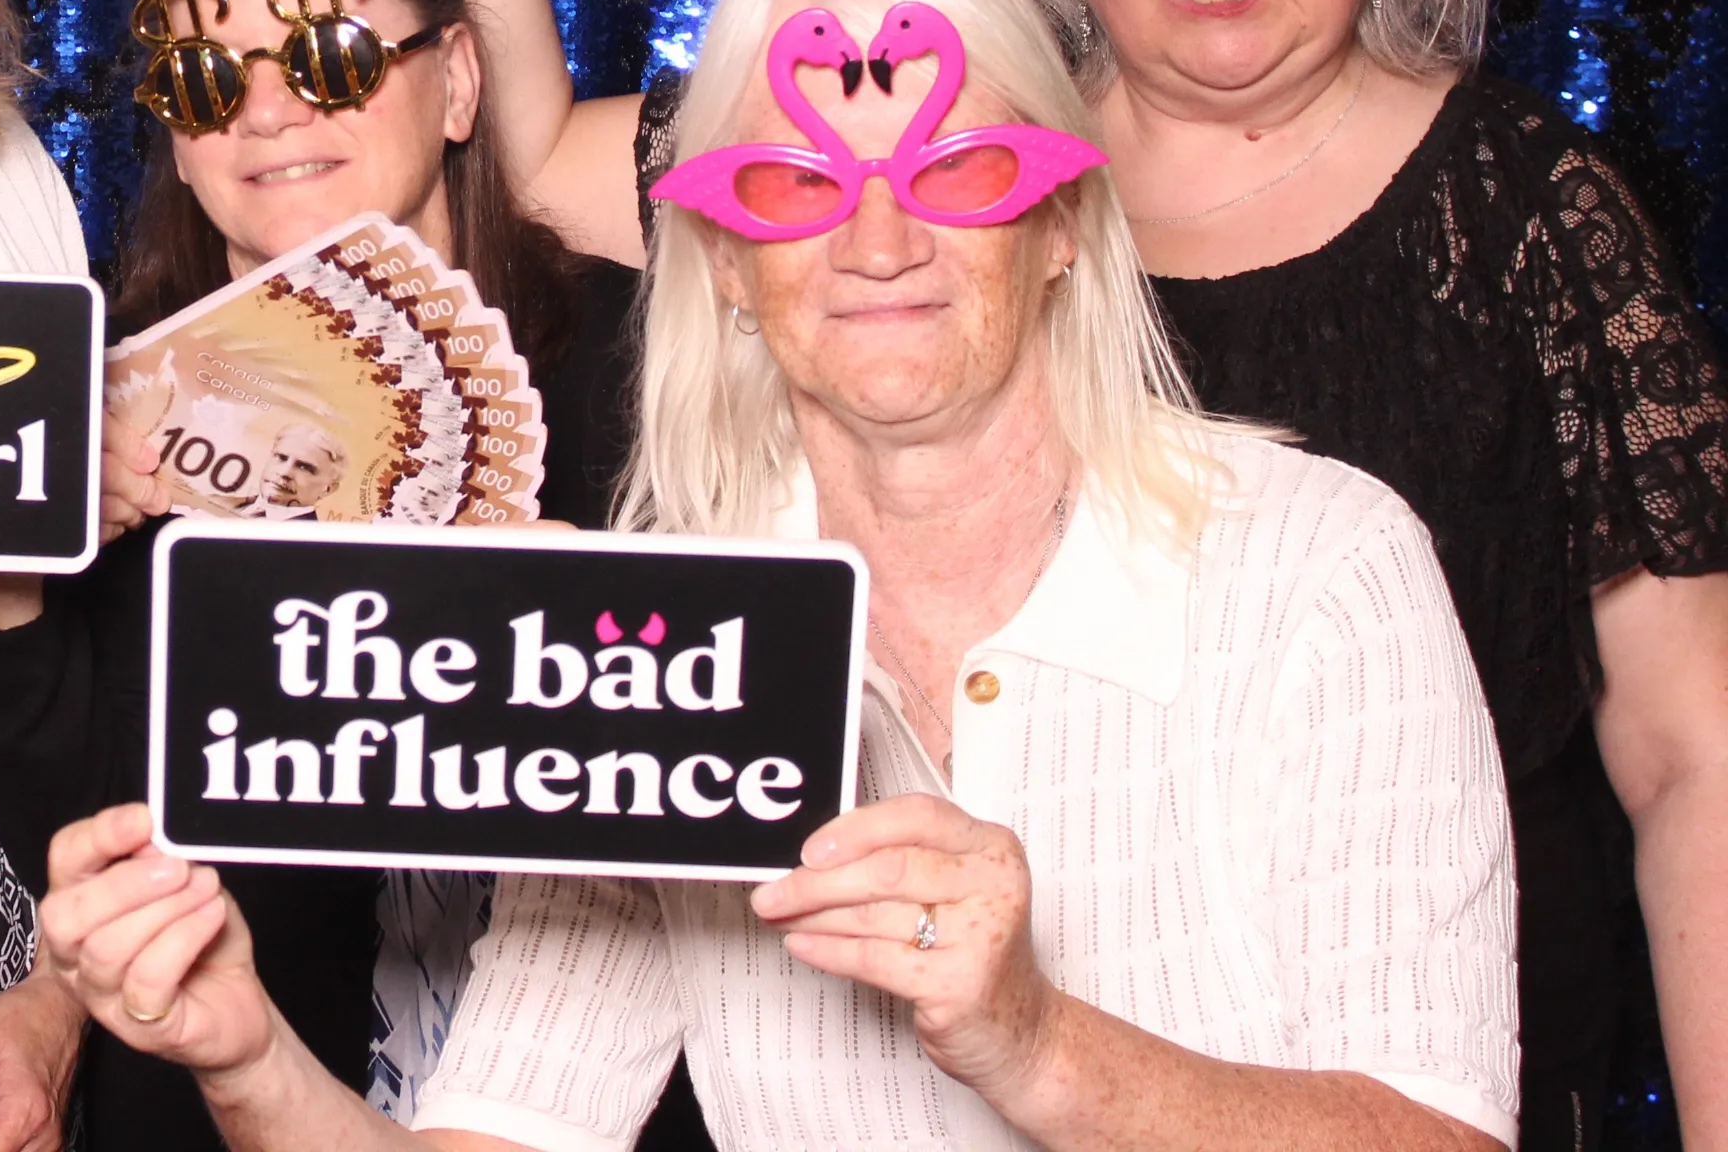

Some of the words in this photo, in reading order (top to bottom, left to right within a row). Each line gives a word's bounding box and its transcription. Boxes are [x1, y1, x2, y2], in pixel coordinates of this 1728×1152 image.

[339, 239, 377, 266] 100
[370, 257, 406, 281] 100
[389, 278, 426, 299] 100
[416, 298, 454, 322] 100
[445, 335, 484, 355] 100
[196, 370, 271, 410] Canada
[464, 377, 501, 397] 100
[480, 408, 516, 428] 100
[480, 435, 518, 457] 100
[158, 426, 251, 493] 100
[476, 466, 513, 492] 100
[471, 499, 508, 523] 100
[273, 590, 477, 703] the
[507, 610, 745, 712] bad
[202, 708, 804, 821] influence
